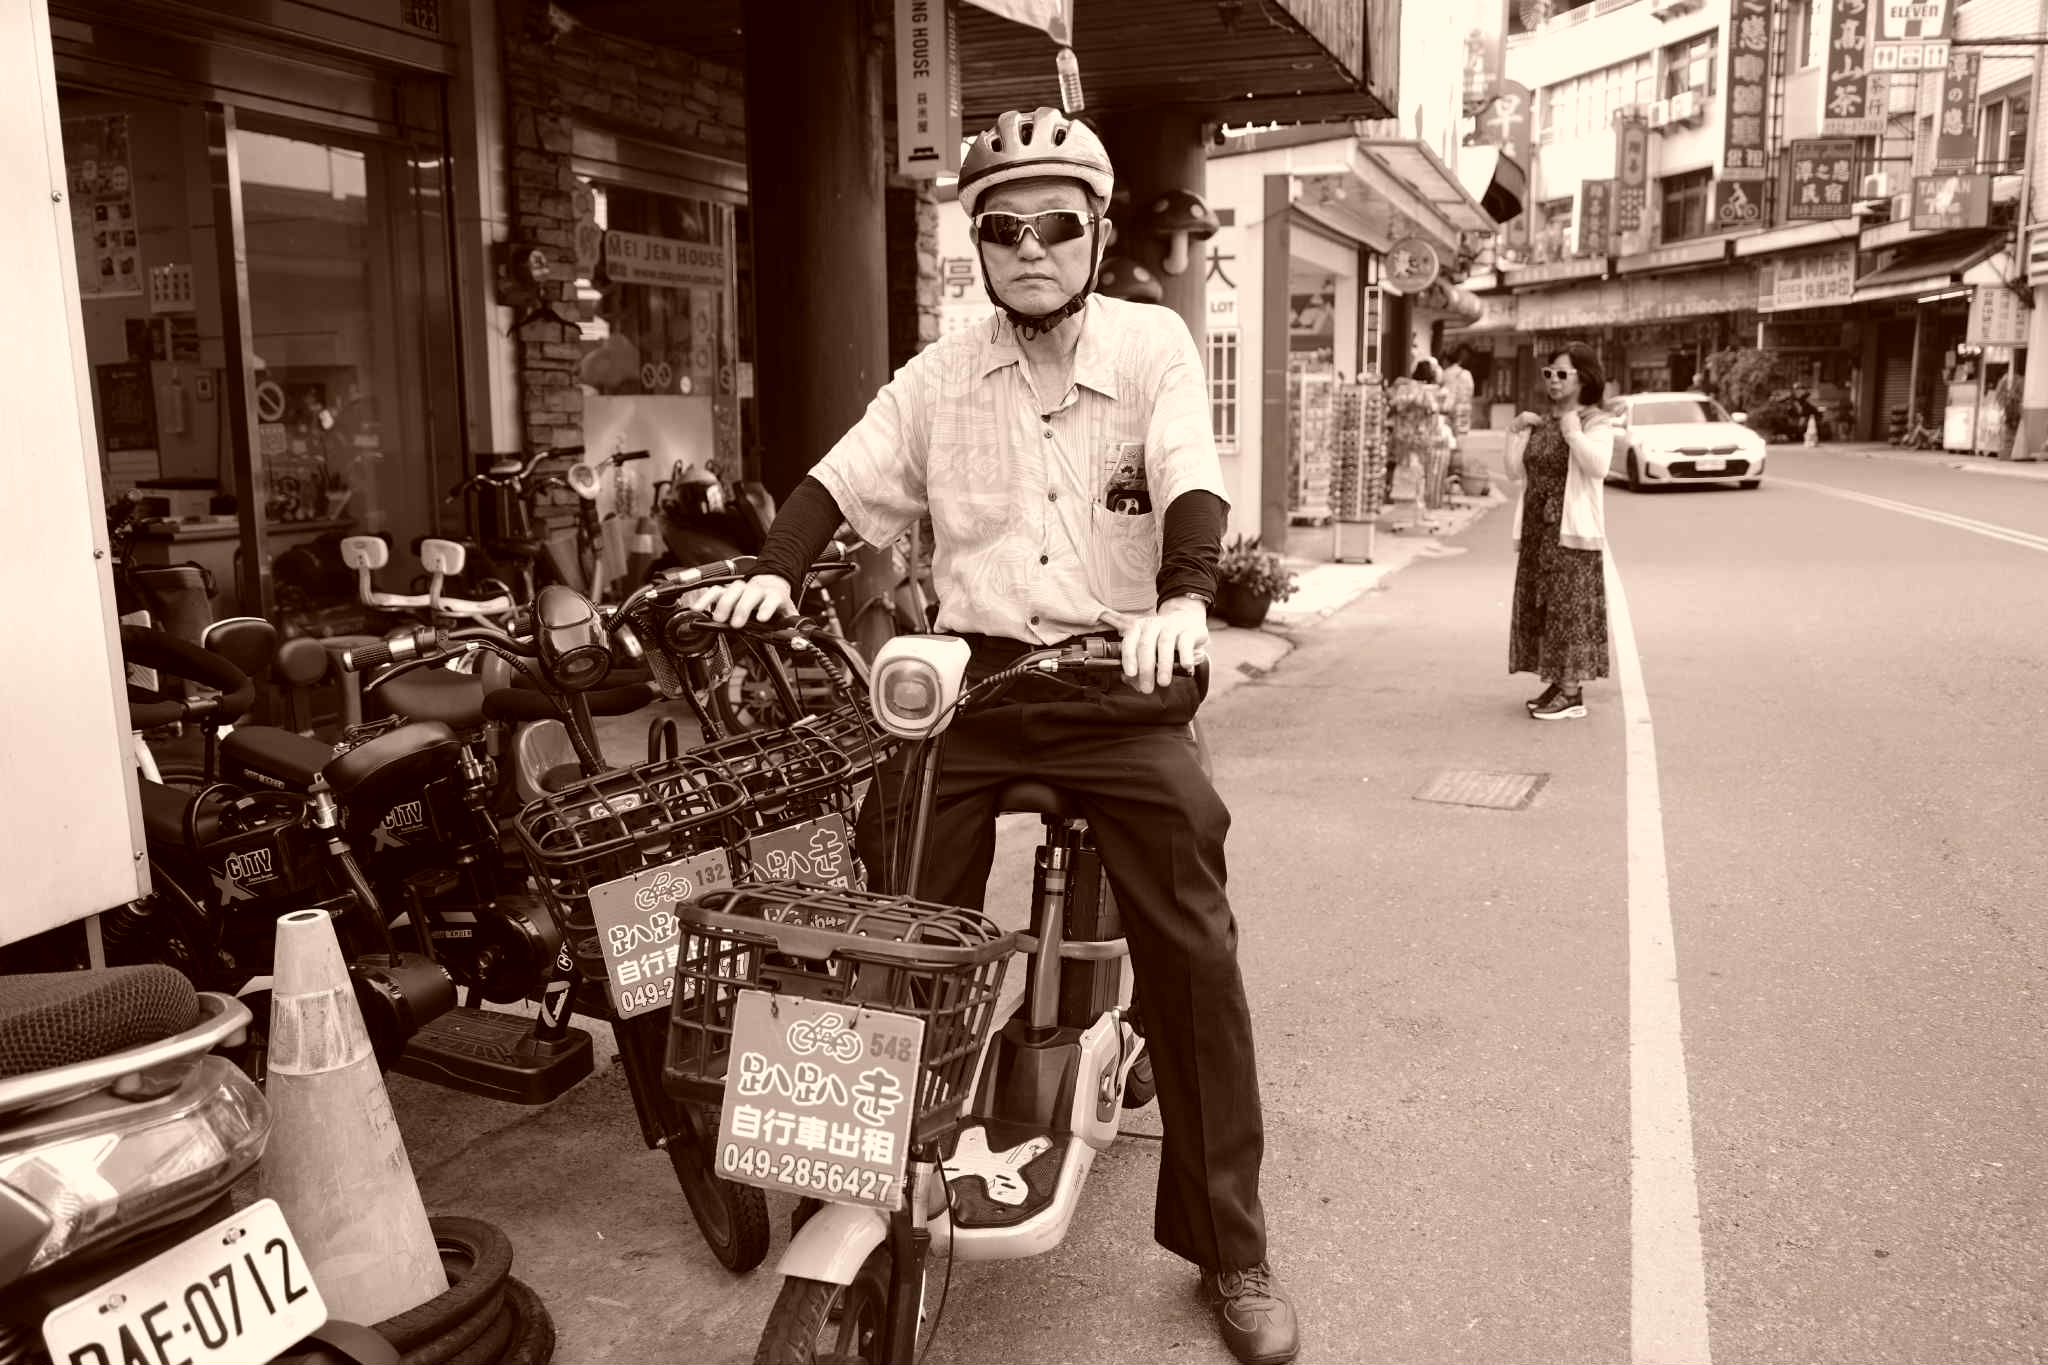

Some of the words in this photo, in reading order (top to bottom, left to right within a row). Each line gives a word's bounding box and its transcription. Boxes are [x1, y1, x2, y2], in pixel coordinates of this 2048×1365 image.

[912, 28, 930, 79] HOUSE
[608, 233, 637, 257] MEI
[644, 239, 671, 261] JEN
[677, 246, 724, 269] HOUSE
[1210, 301, 1234, 314] LOT
[226, 848, 272, 880] CITY
[695, 863, 726, 887] 132
[869, 1032, 913, 1063] 548
[738, 1052, 904, 1127] 趴趴走
[731, 1103, 896, 1165] 自行車出租
[722, 1143, 894, 1202] 049-2856427
